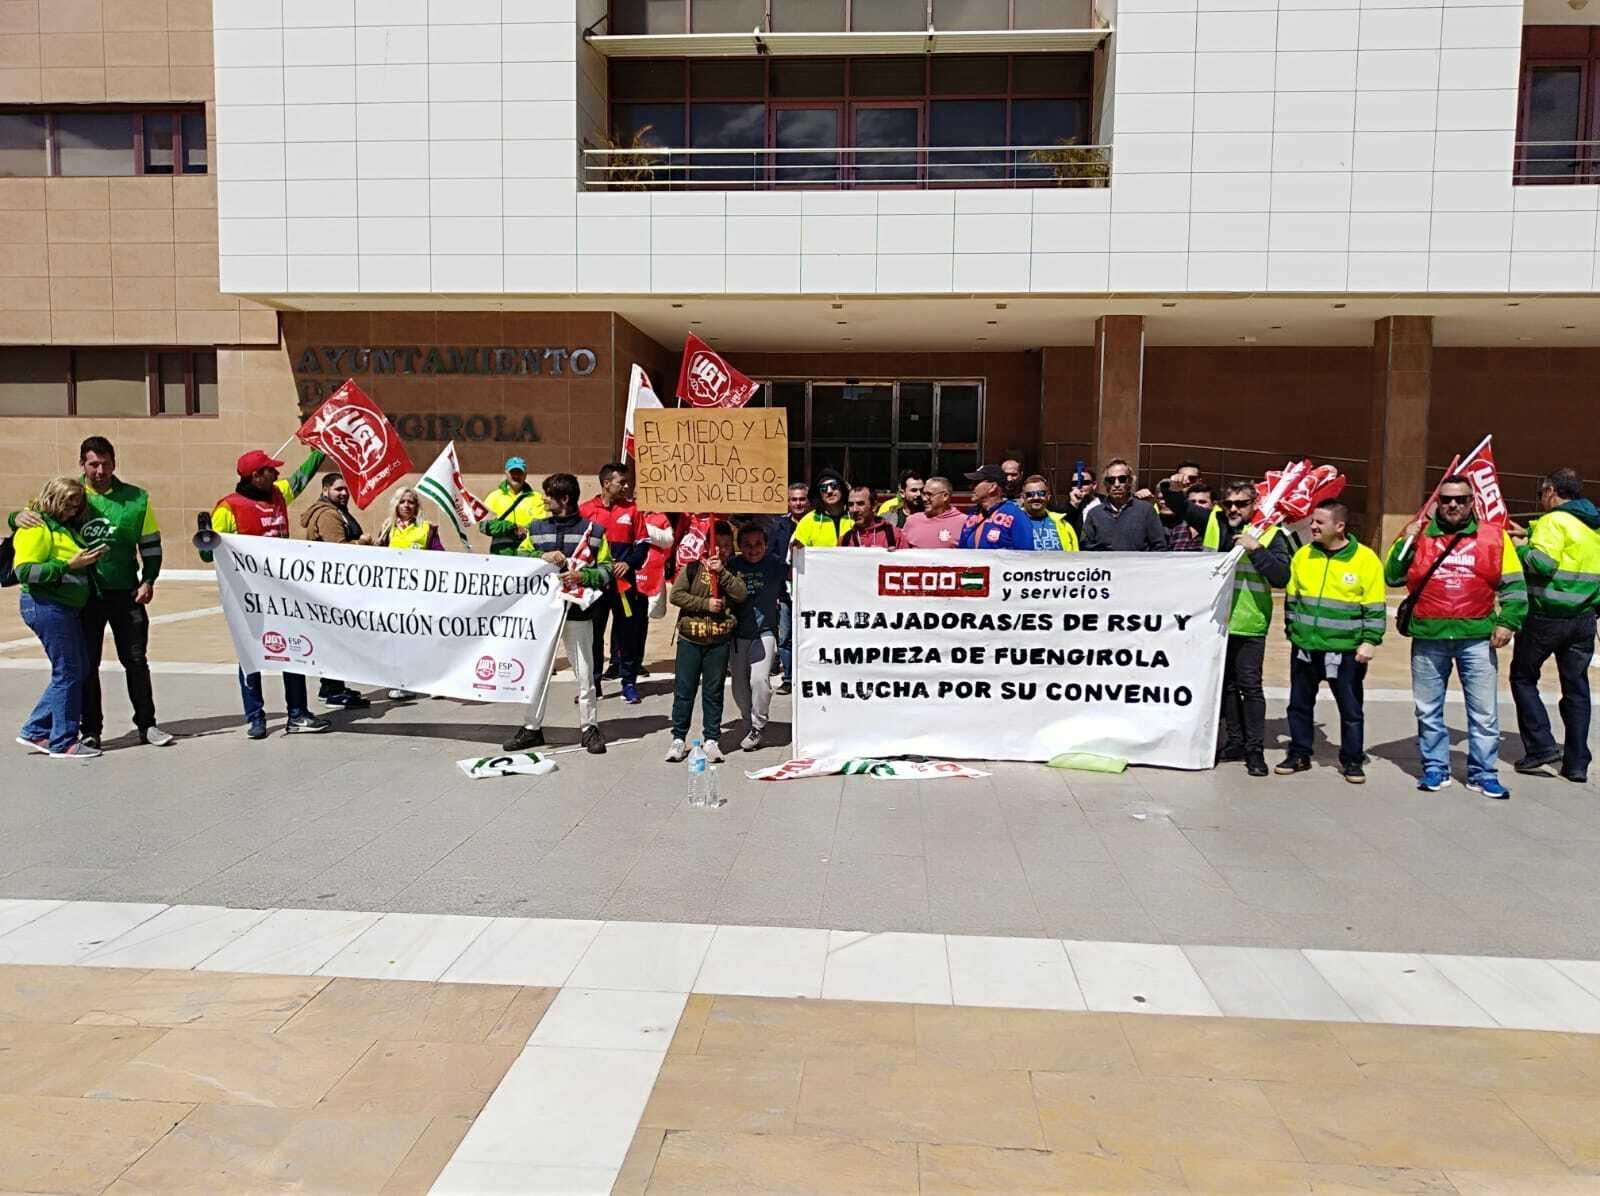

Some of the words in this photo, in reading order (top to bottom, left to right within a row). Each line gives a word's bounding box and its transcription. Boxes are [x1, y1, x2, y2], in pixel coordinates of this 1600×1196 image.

[299, 346, 598, 376] AYUNTAMIENTO
[691, 354, 728, 392] UGT
[335, 411, 384, 459] UGT
[644, 420, 669, 444] EL
[677, 419, 734, 444] MIEDO
[743, 421, 754, 441] Y
[764, 418, 787, 440] LA
[638, 443, 741, 466] PESADILLA
[640, 464, 705, 484] SOMOS
[640, 486, 688, 504] TROS
[1473, 466, 1507, 522] UGT
[232, 551, 258, 574] NO
[263, 556, 275, 578] A
[279, 557, 316, 582] LOS
[320, 561, 419, 590] RECORTES
[424, 569, 449, 593] DE
[454, 571, 551, 597] DERECHOS
[885, 572, 957, 590] CCOO
[1003, 568, 1112, 582] construcción
[1002, 588, 1012, 601] y
[1021, 585, 1110, 599] servicios
[244, 592, 263, 614] SI
[267, 594, 279, 616] A
[281, 597, 305, 620] LA
[306, 602, 433, 636] NEGOCIACIÓN
[439, 615, 538, 641] COLECTIVA
[800, 610, 1053, 631] TRABAJADORAS/ES
[1063, 614, 1098, 631] DE
[1107, 614, 1162, 632] RSU
[1174, 614, 1192, 631] Y
[819, 646, 942, 665] LIMPIEZA
[951, 647, 986, 664] DE
[994, 648, 1170, 667] FUENGIROLA
[801, 681, 832, 699] EN
[841, 680, 929, 700] LUCHA
[938, 681, 992, 699] POR
[1001, 682, 1037, 700] SU
[1046, 682, 1192, 706] CONVENIO
